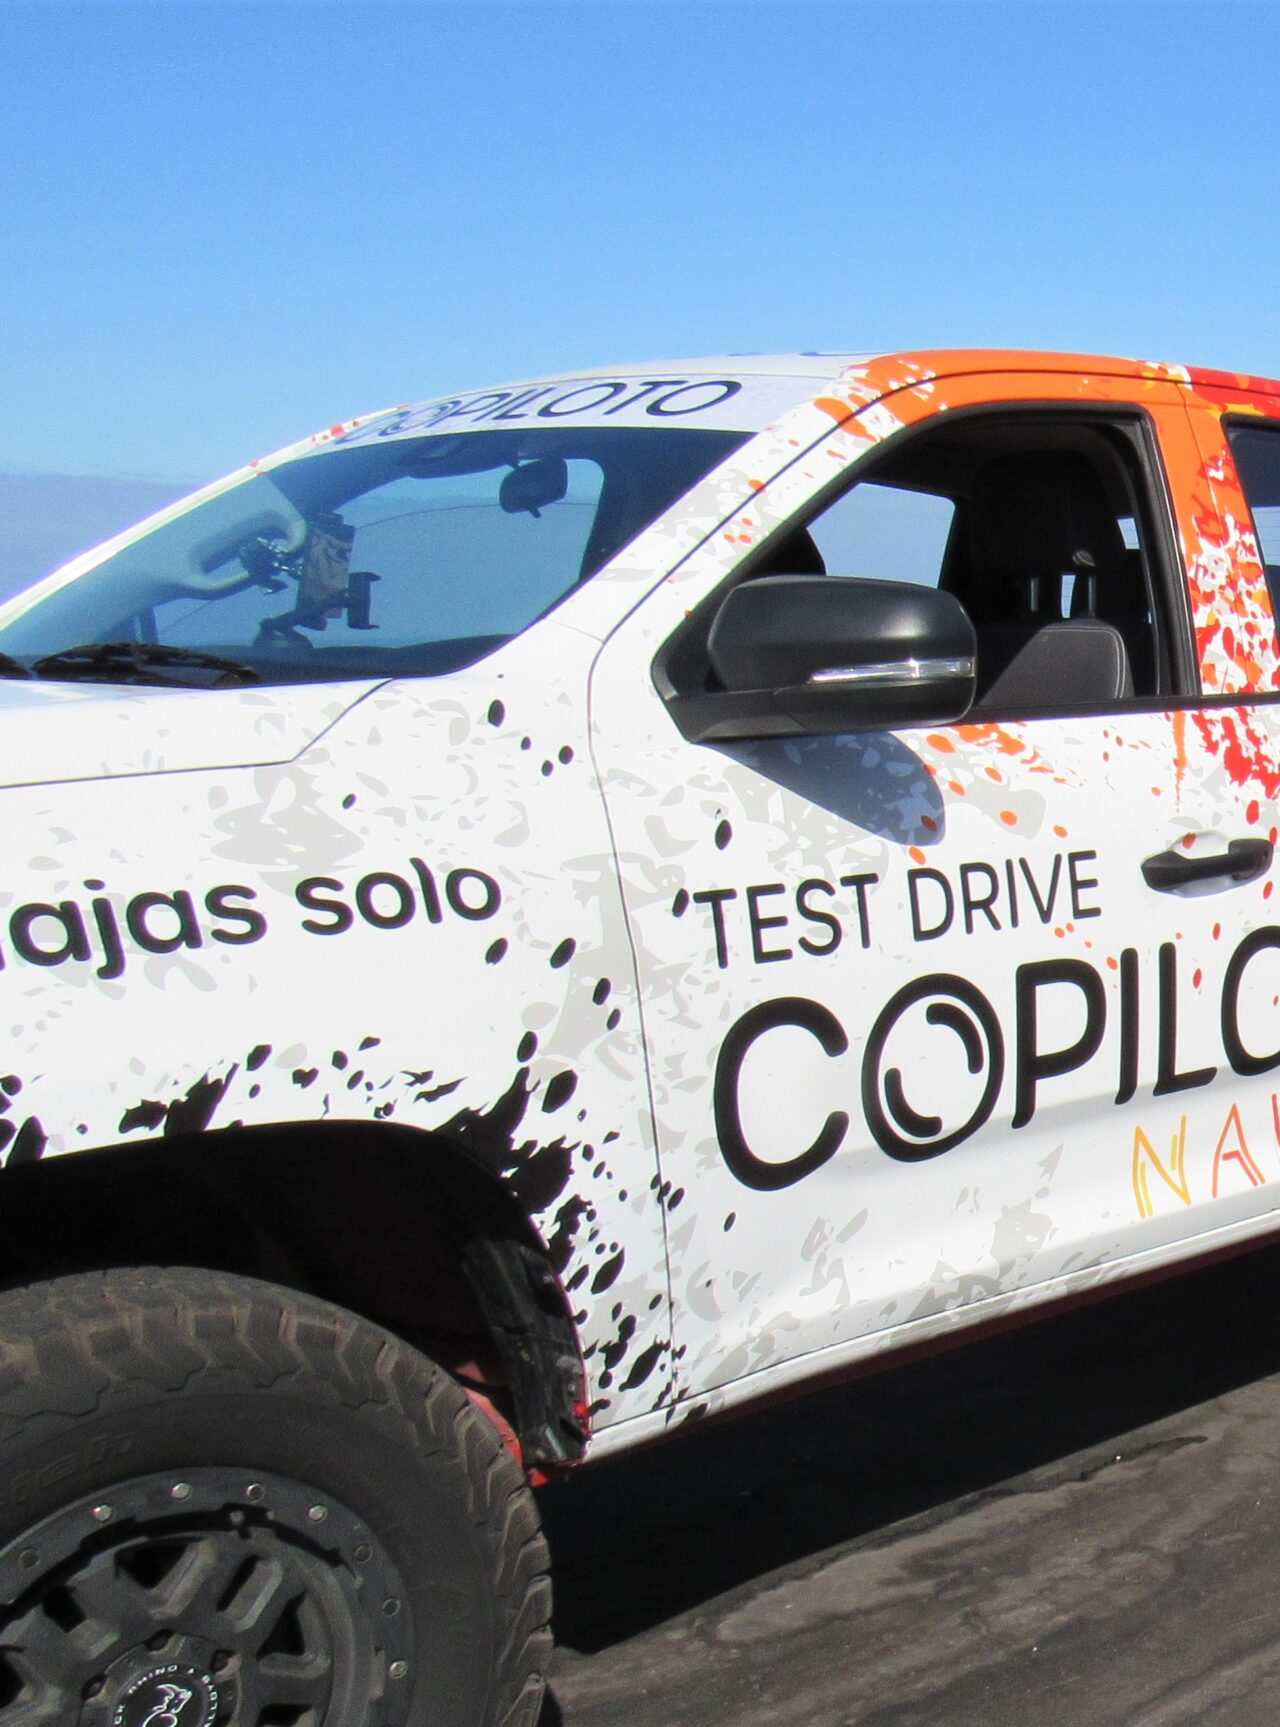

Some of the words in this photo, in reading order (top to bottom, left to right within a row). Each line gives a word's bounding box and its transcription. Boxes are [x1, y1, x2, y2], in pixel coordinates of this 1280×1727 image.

[335, 380, 742, 444] COPILOTO
[0, 878, 268, 980] ajas
[295, 857, 501, 936] solo
[693, 873, 879, 969] TEST
[908, 850, 1102, 942] DRIVE
